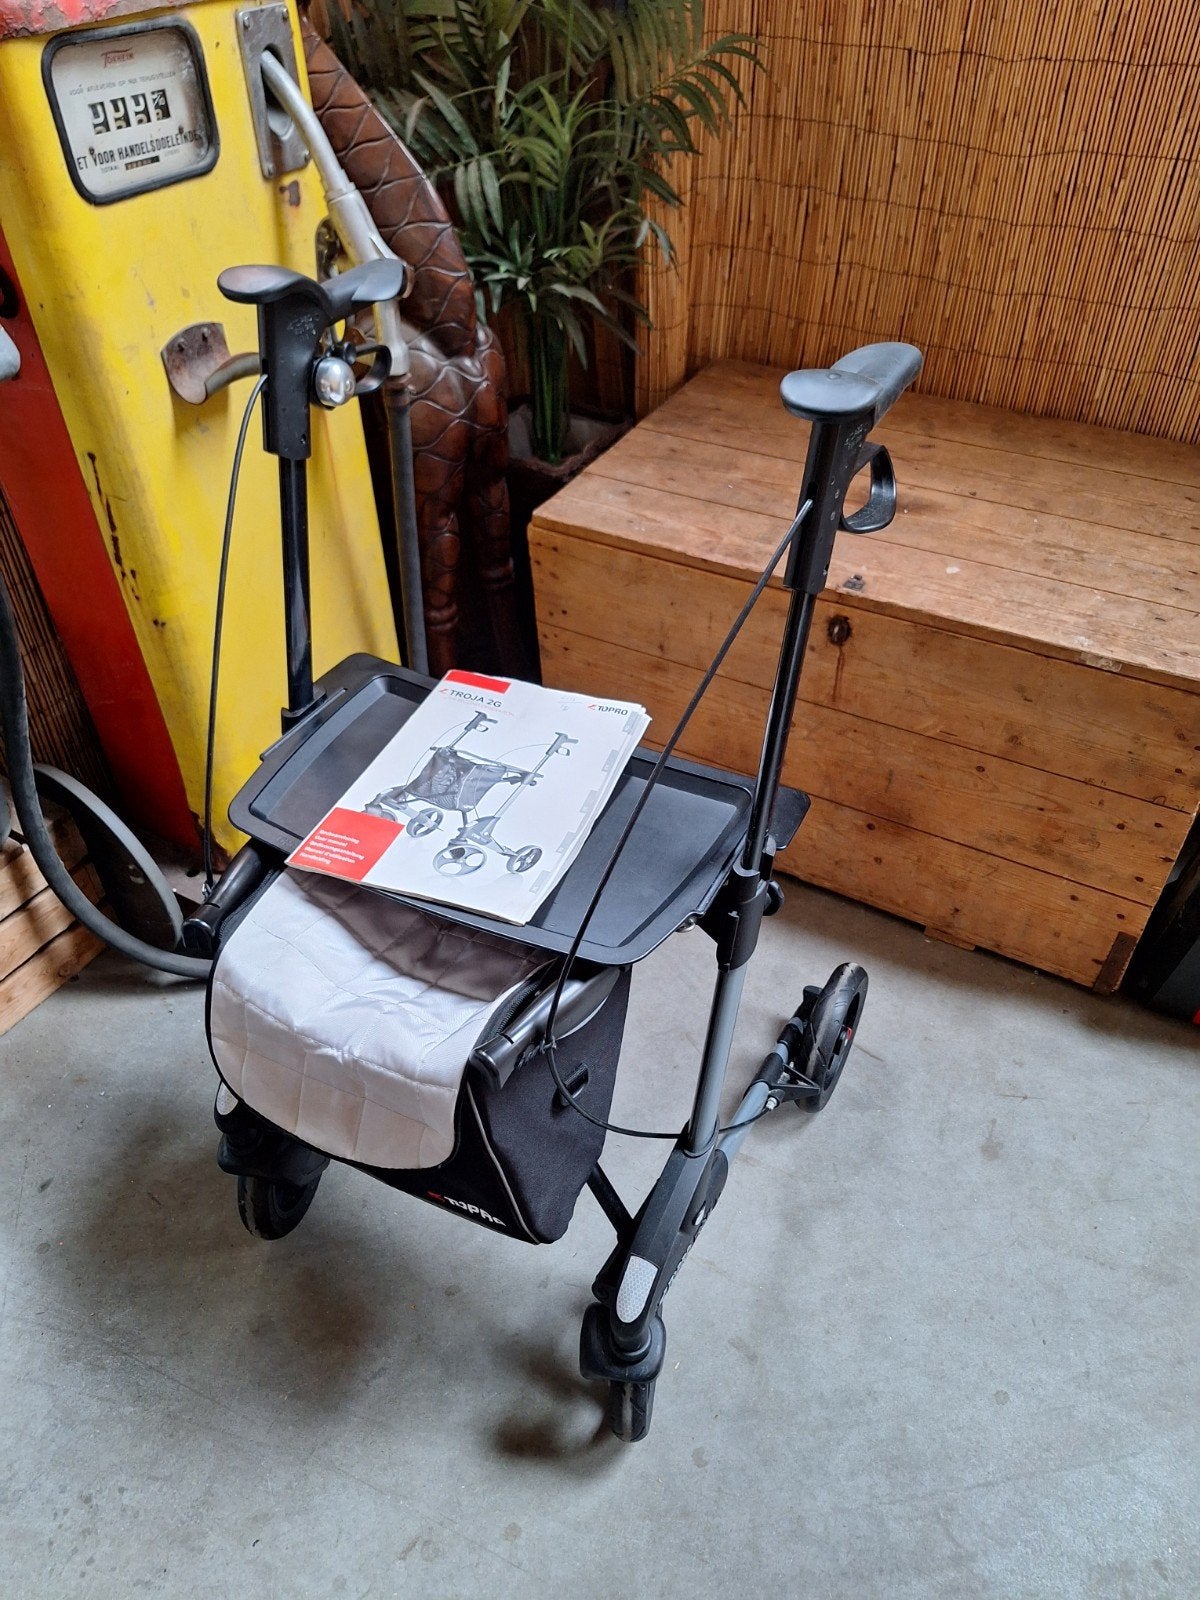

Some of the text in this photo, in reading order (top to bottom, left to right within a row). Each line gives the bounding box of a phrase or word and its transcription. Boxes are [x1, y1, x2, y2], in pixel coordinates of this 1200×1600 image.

[91, 149, 116, 167] VOOR
[449, 689, 484, 703] TROJA
[487, 699, 503, 708] 2G
[597, 704, 629, 717] TOPRO
